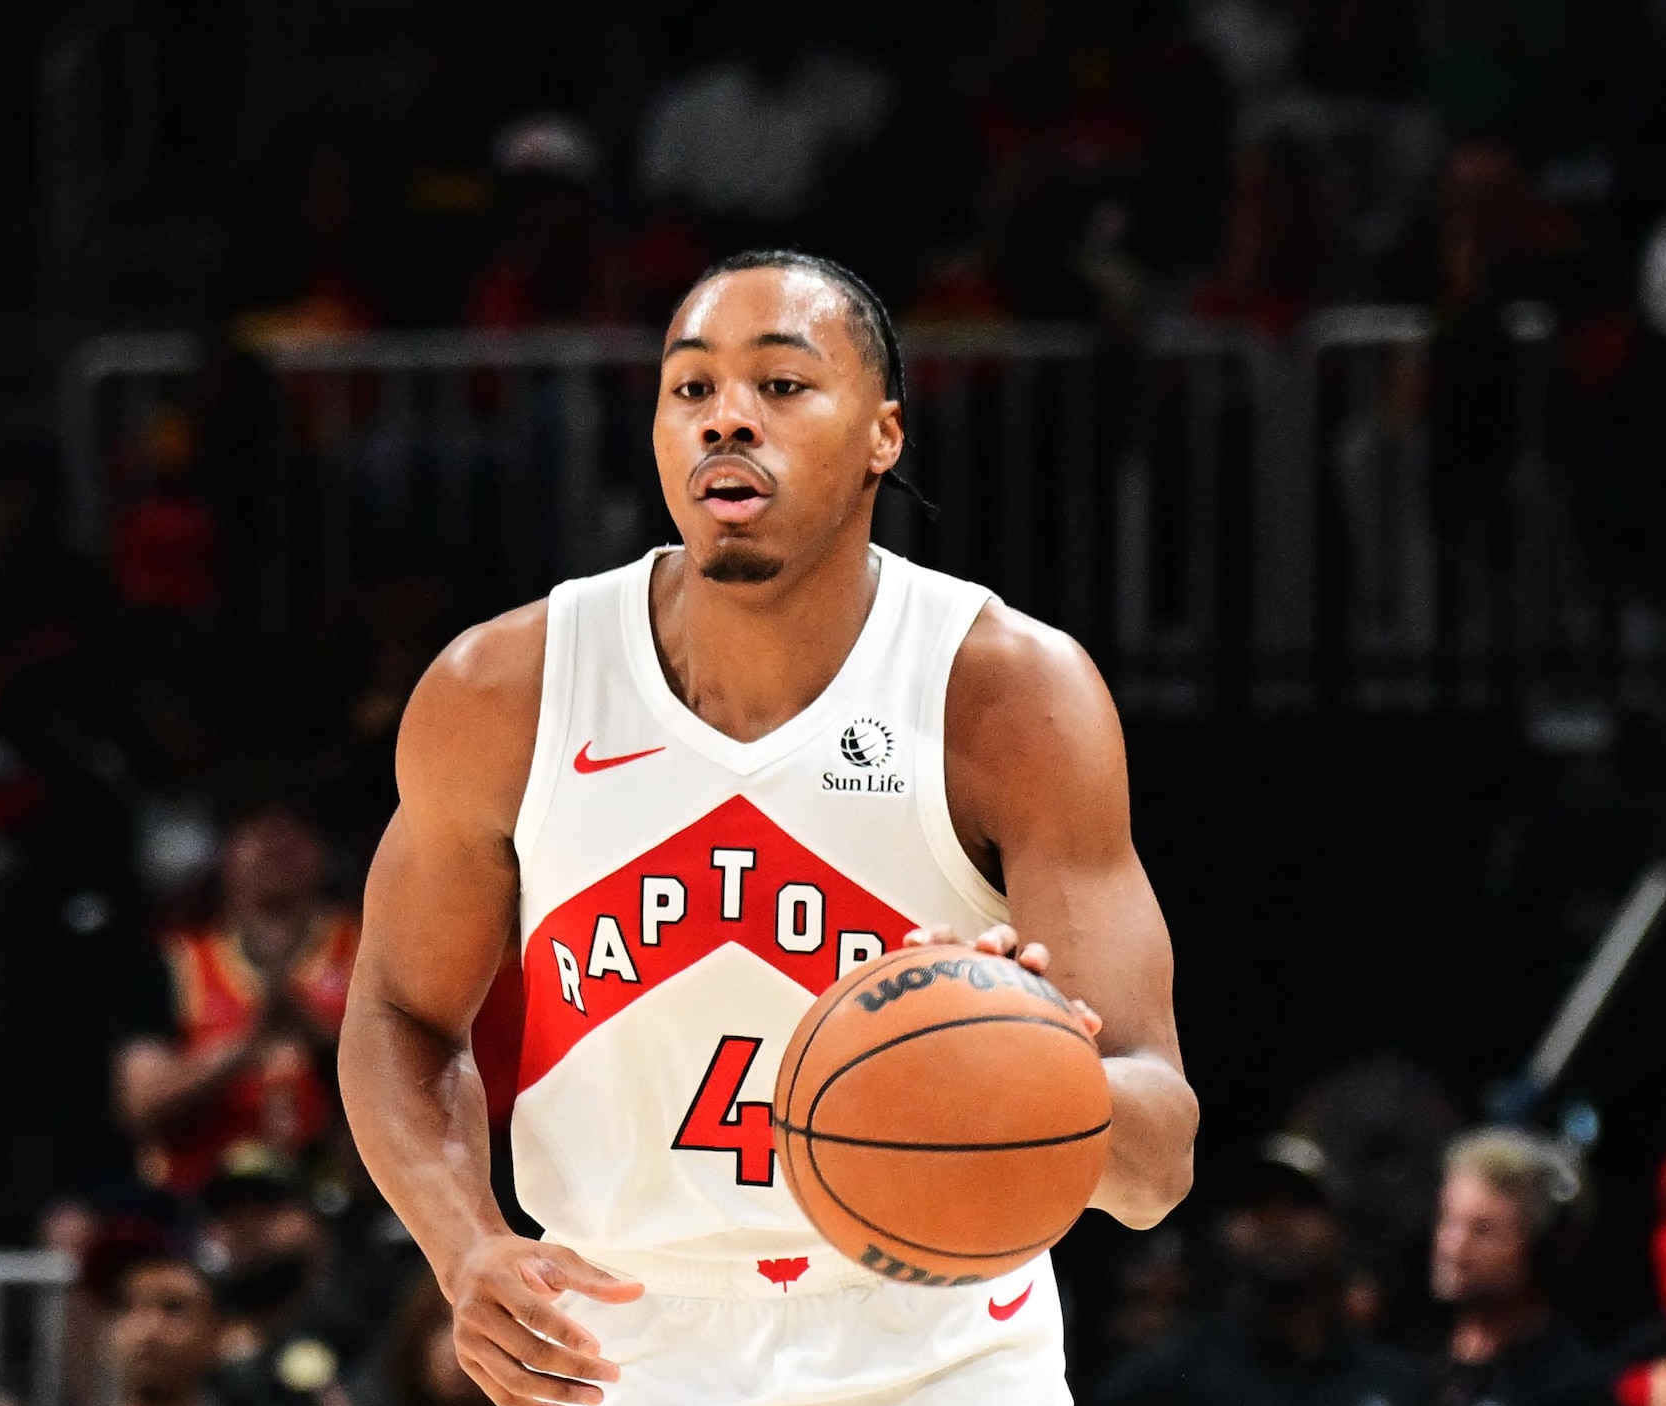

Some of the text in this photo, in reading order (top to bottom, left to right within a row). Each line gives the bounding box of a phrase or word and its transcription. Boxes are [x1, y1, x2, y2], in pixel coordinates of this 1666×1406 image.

[822, 771, 905, 793] Sun Life
[550, 847, 886, 1017] RAPTOR
[671, 1034, 776, 1187] 4
